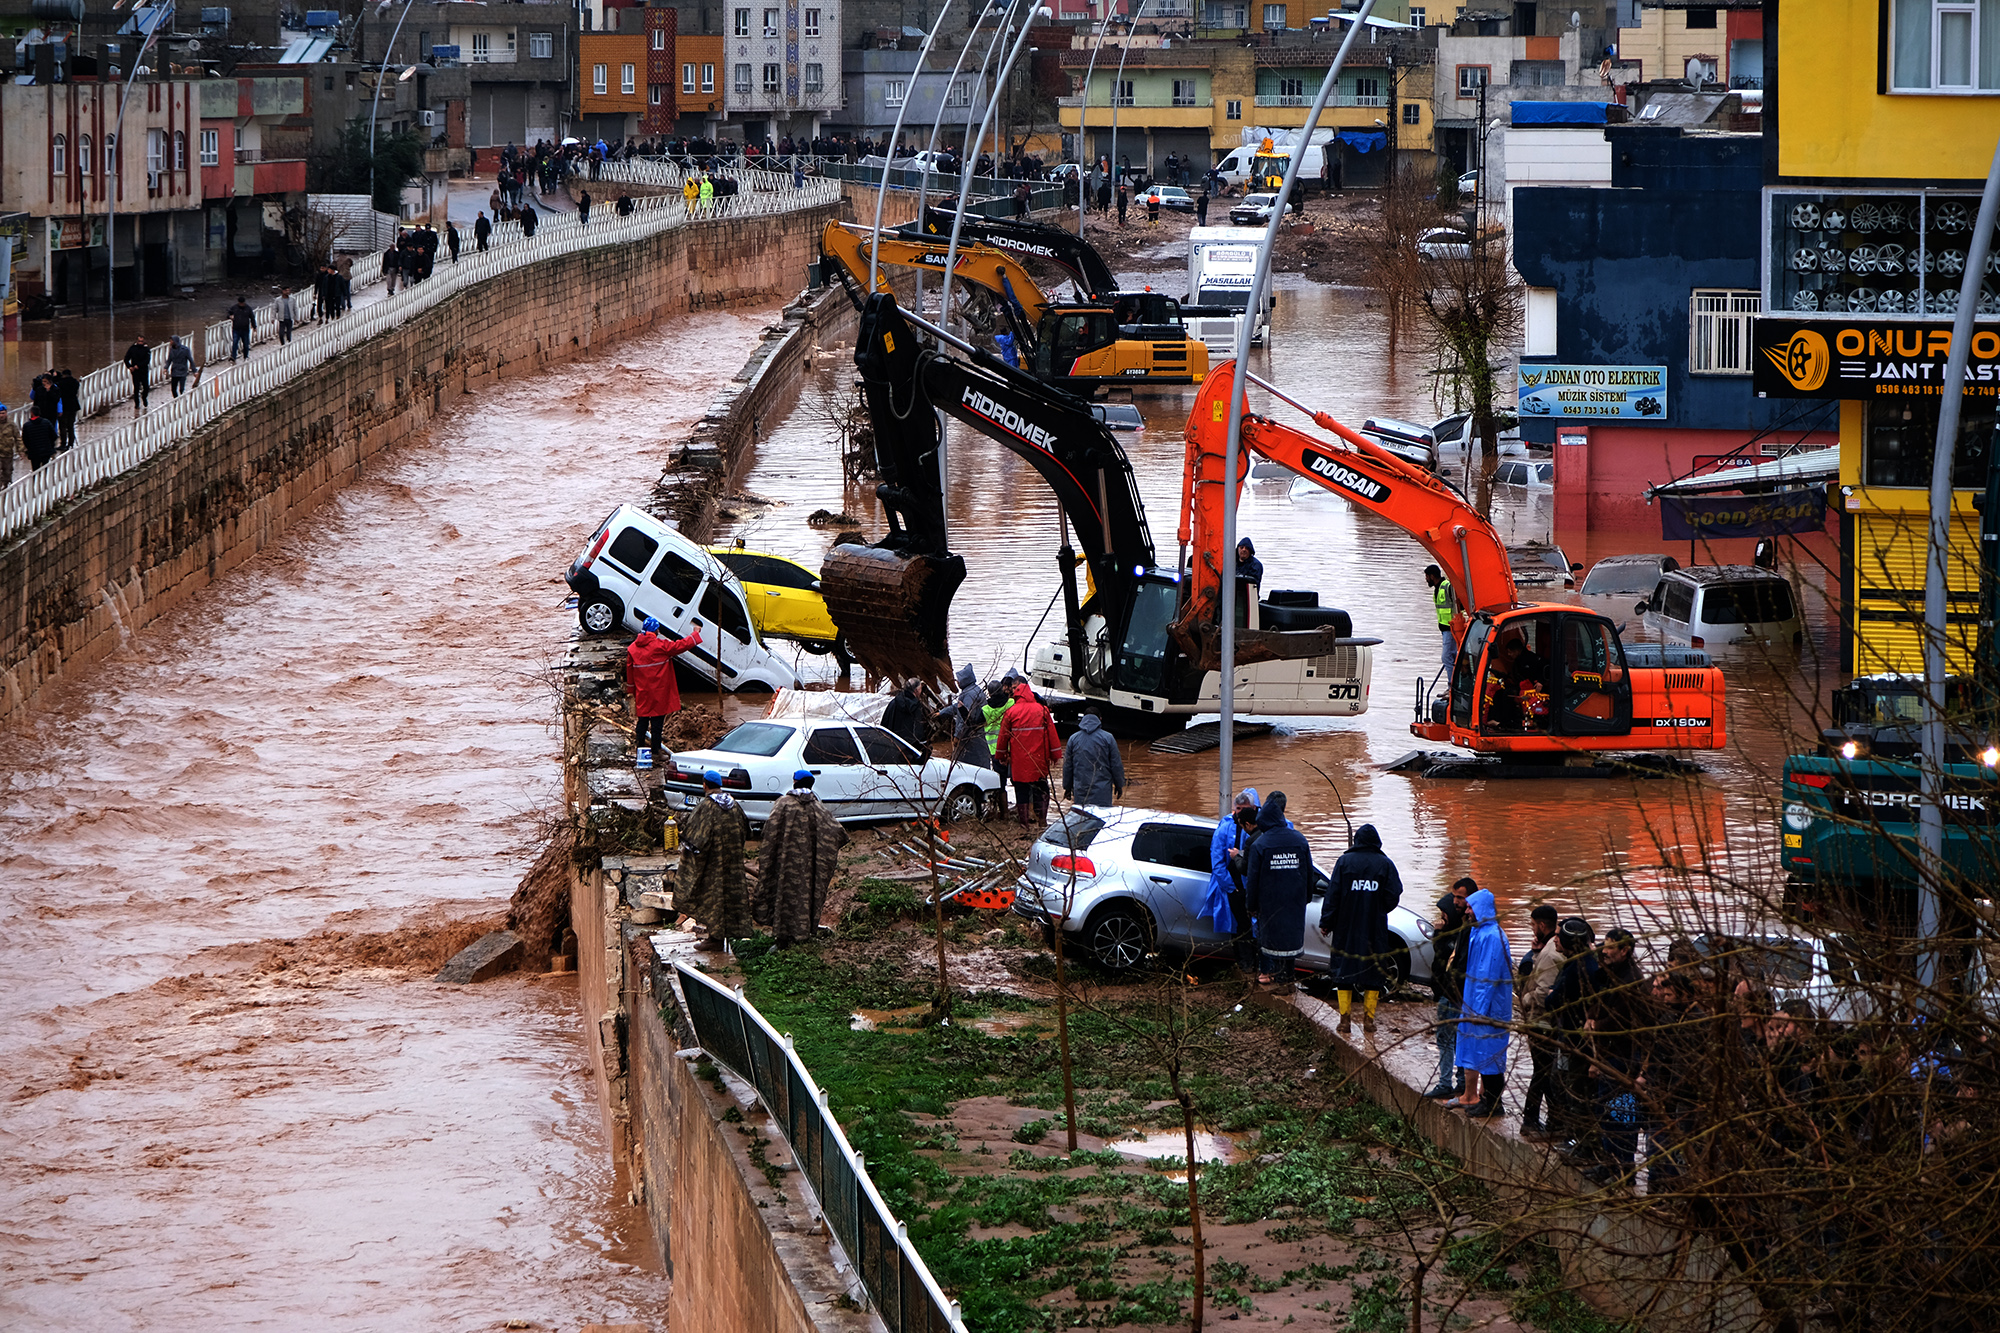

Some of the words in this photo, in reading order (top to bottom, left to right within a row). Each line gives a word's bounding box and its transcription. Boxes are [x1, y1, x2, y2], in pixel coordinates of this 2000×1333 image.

[925, 254, 957, 265] SAN
[1836, 329, 1953, 357] ONUR
[1869, 362, 1935, 379] JANT
[1545, 370, 1580, 385] ADNAN
[1583, 370, 1606, 385] OTO
[1558, 389, 1587, 402] MÜZİK
[1590, 389, 1627, 402] SİSTEMİ
[1876, 384, 1899, 394] 0506
[1902, 385, 1920, 394] 463
[1922, 385, 1933, 395] 18
[1935, 385, 1945, 395] 18
[1978, 387, 1995, 396] 740
[1563, 406, 1581, 415] 0543
[1584, 406, 1597, 415] 733
[1600, 406, 1608, 415] 34
[1611, 406, 1620, 415] 63
[1717, 458, 1752, 466] LASSA
[1310, 456, 1381, 498] DOOSAN
[1328, 684, 1360, 700] 370
[1351, 880, 1379, 891] AFAD
